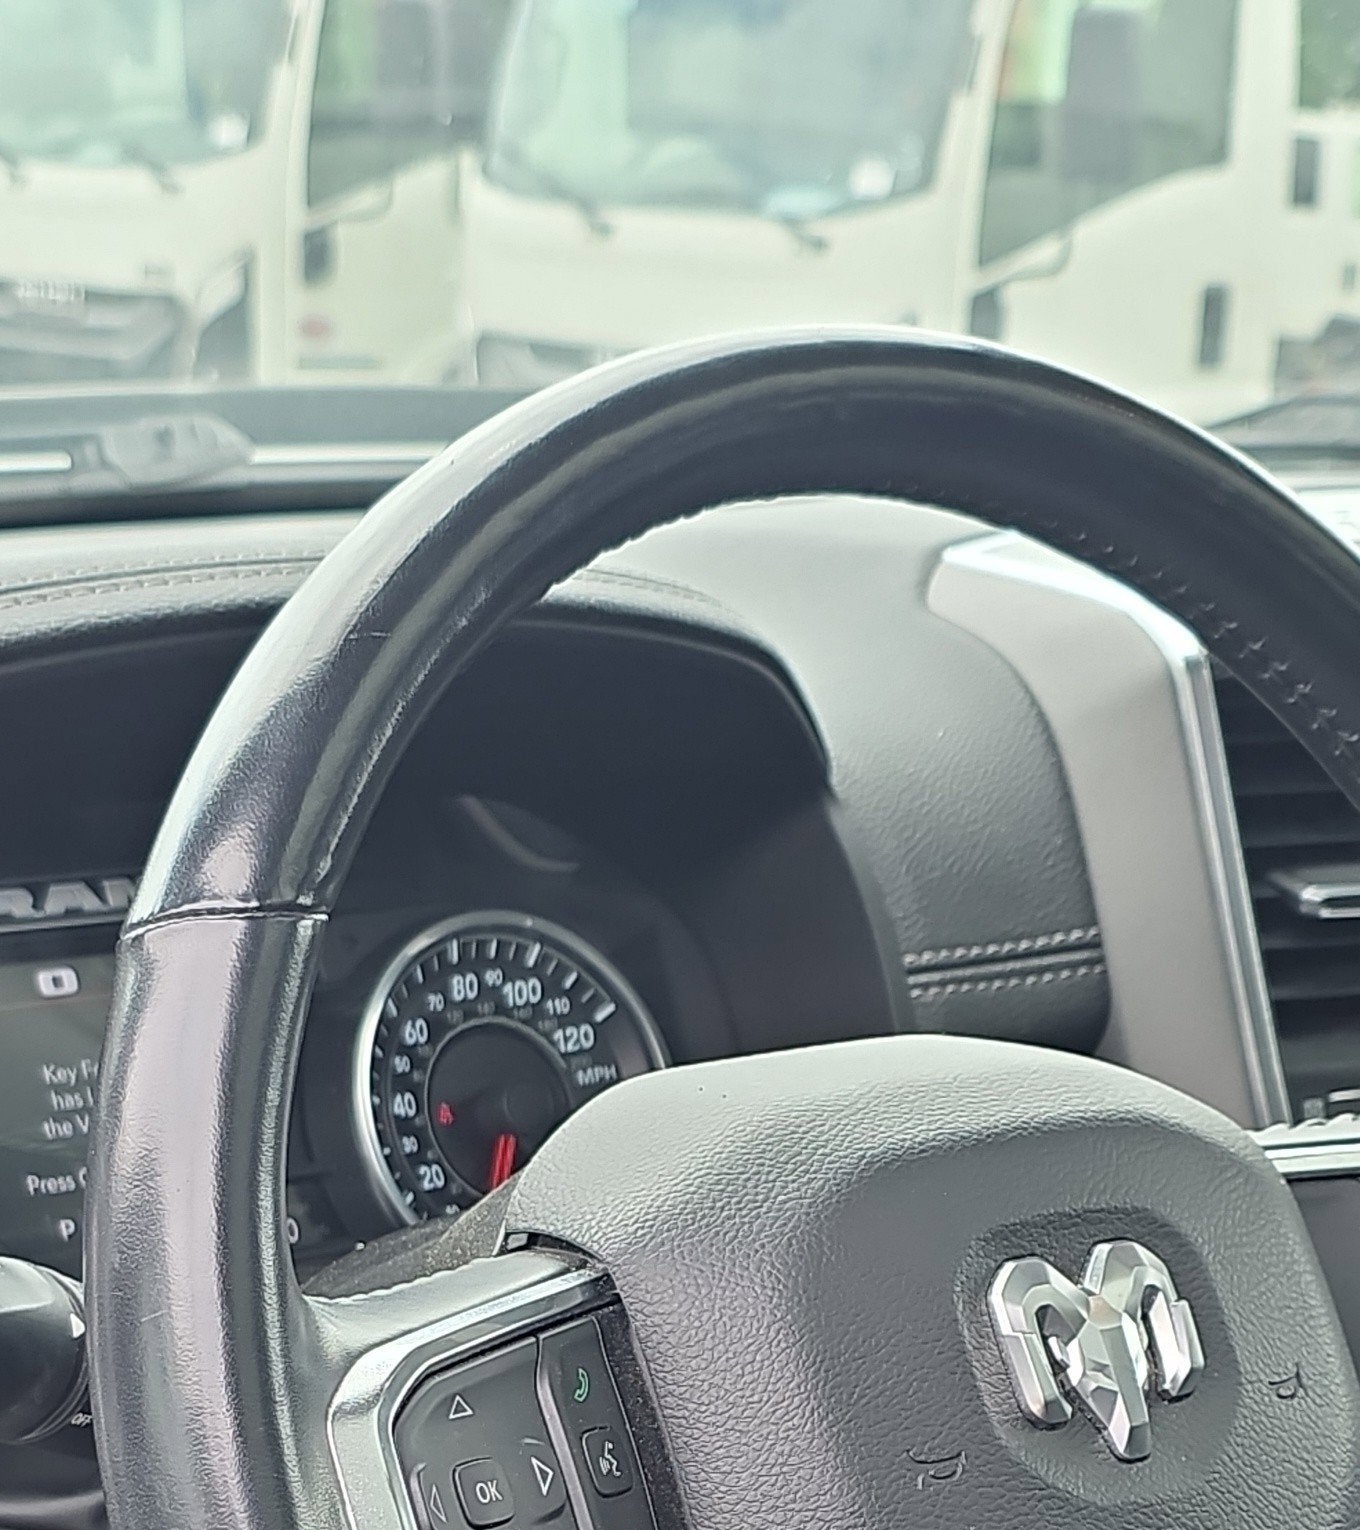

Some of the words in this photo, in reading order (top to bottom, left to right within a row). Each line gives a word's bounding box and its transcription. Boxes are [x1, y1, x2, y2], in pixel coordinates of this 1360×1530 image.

[452, 972, 479, 1002] 80
[502, 977, 542, 1007] 100
[546, 996, 571, 1016] 110
[404, 1018, 428, 1046] 60
[553, 1022, 595, 1054] 120
[42, 1064, 78, 1086] Key
[576, 1064, 617, 1086] MPH
[51, 1089, 85, 1111] has
[393, 1092, 417, 1118] 40
[42, 1116, 74, 1140] the
[26, 1174, 76, 1196] Press
[419, 1163, 445, 1191] 20
[59, 1218, 77, 1242] P
[475, 1479, 503, 1504] OK
